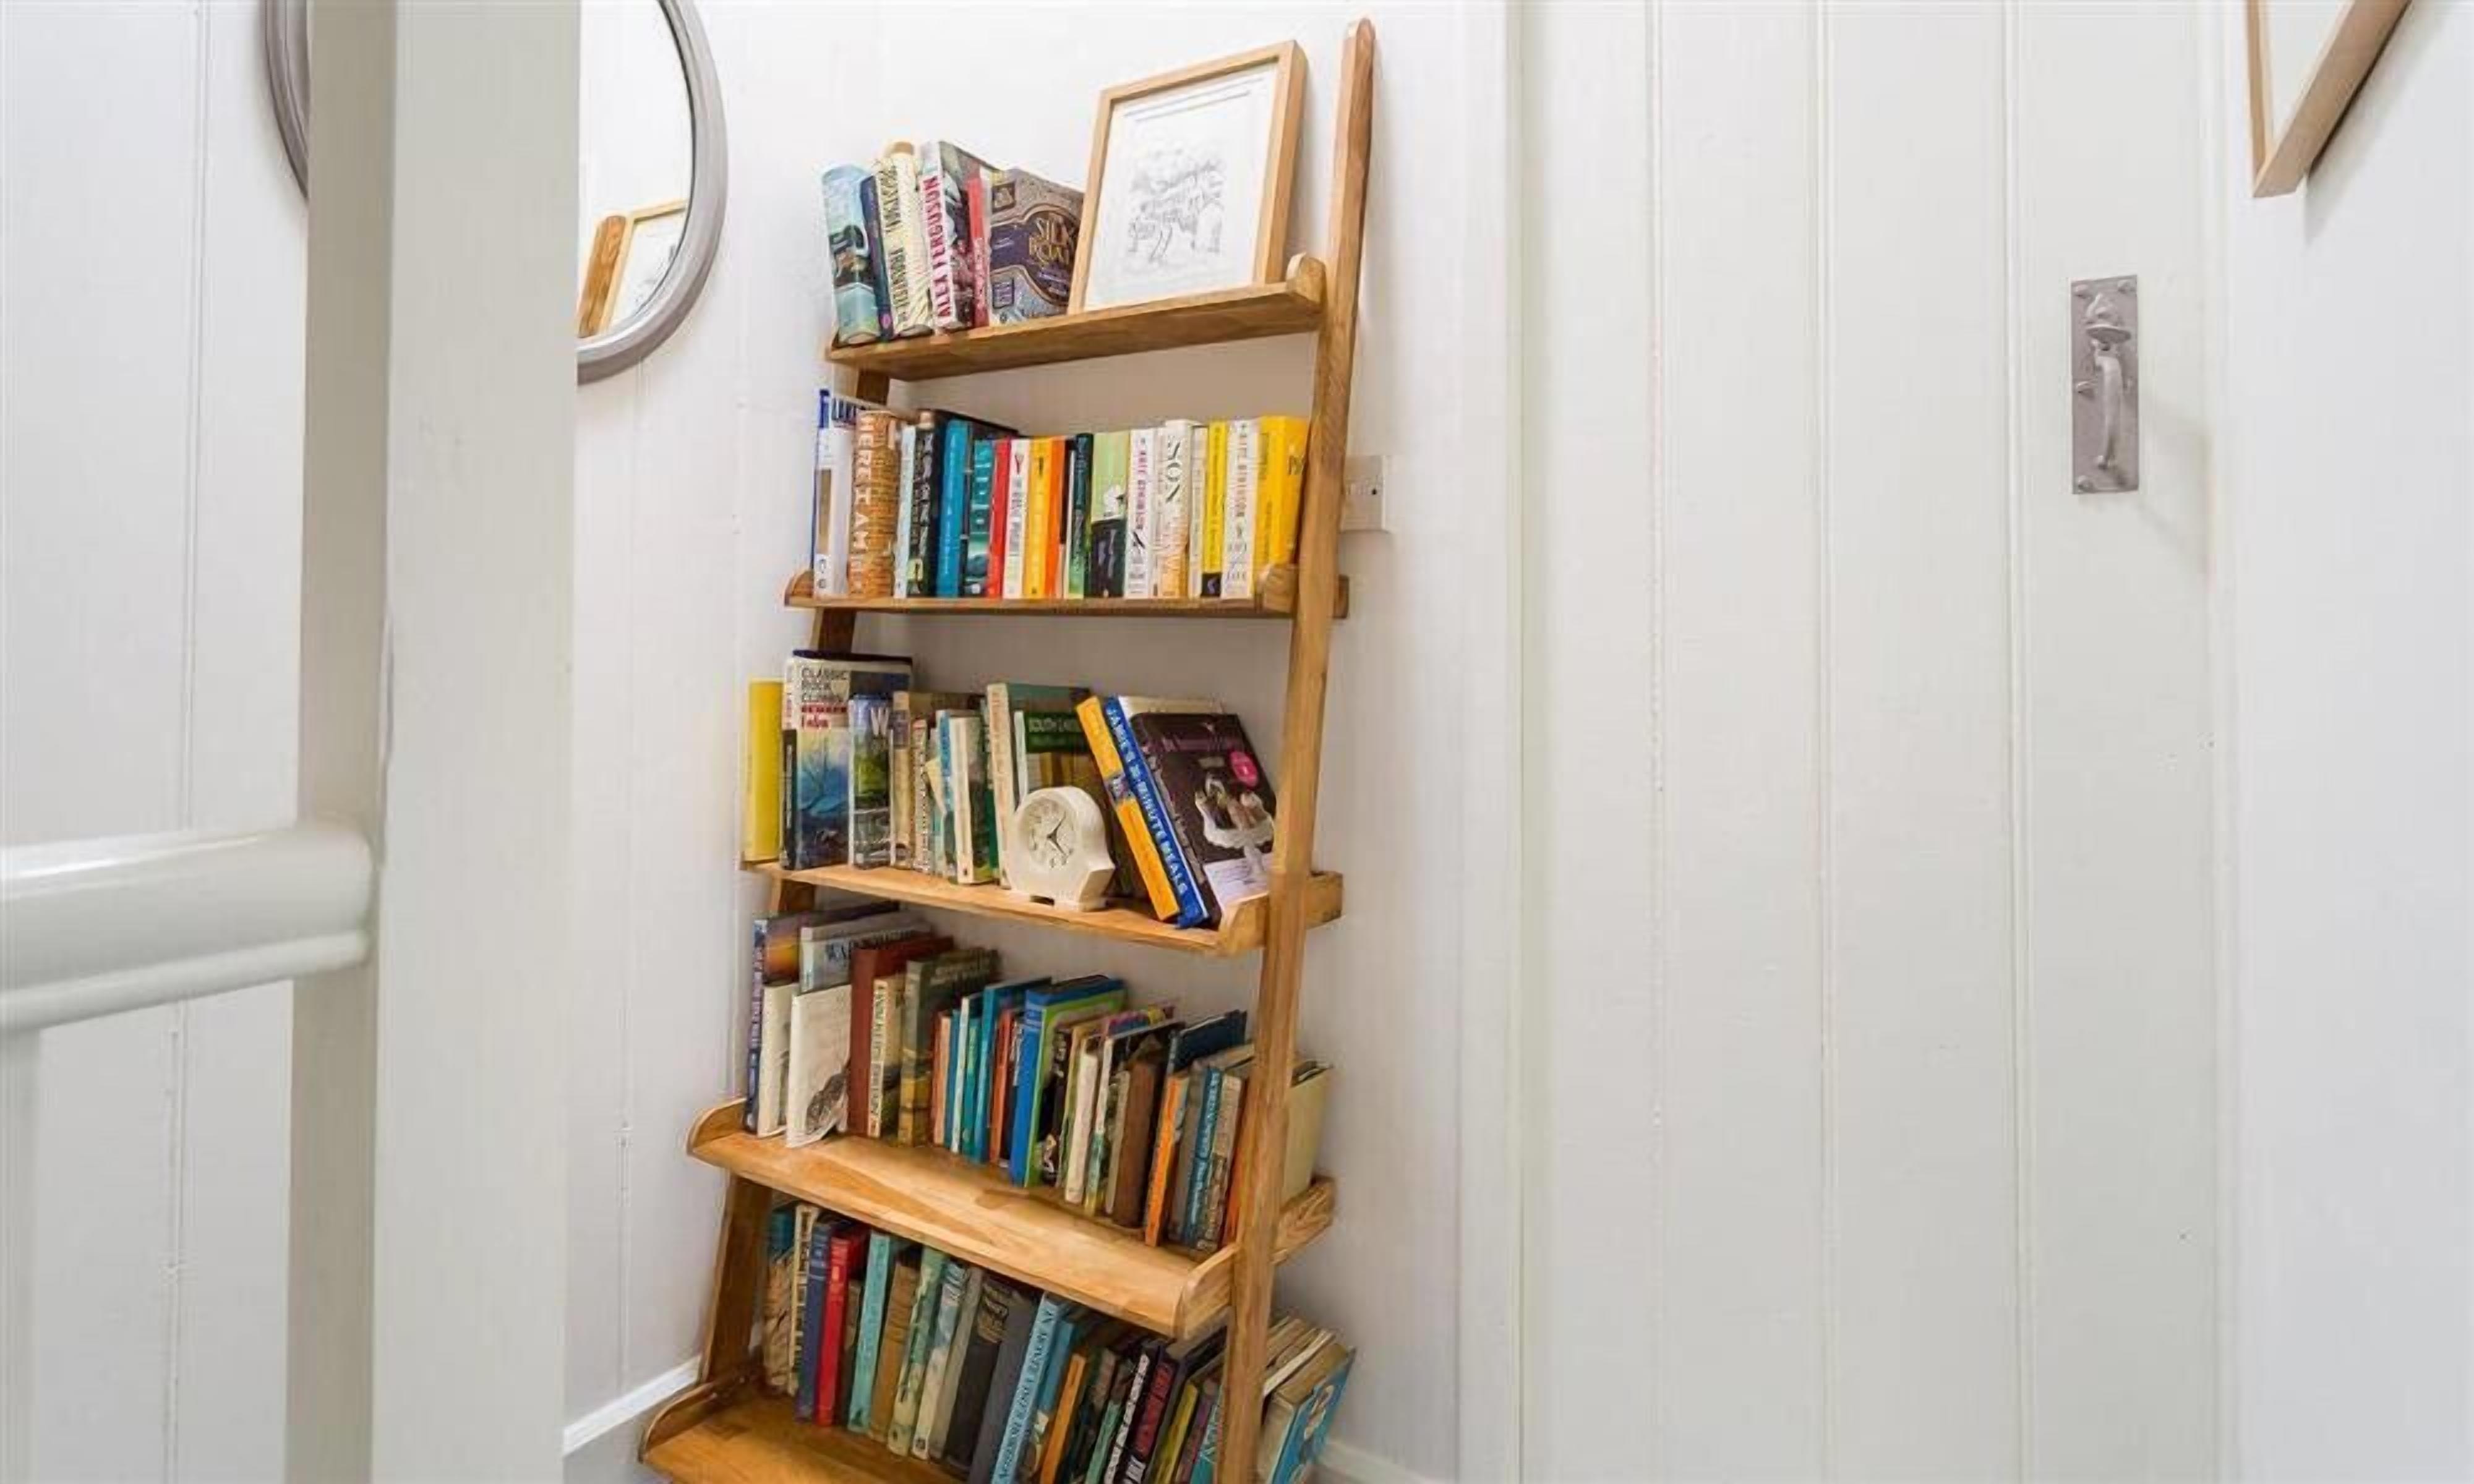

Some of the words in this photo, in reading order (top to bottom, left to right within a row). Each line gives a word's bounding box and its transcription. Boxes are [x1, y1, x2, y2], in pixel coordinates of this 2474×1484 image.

[922, 175, 946, 270] FERGUSON
[933, 273, 951, 317] ALEX
[855, 414, 875, 483] HERE
[1165, 437, 1181, 503] SON
[855, 485, 871, 505] I
[853, 511, 870, 550] AM
[1159, 840, 1189, 896] MEALS
